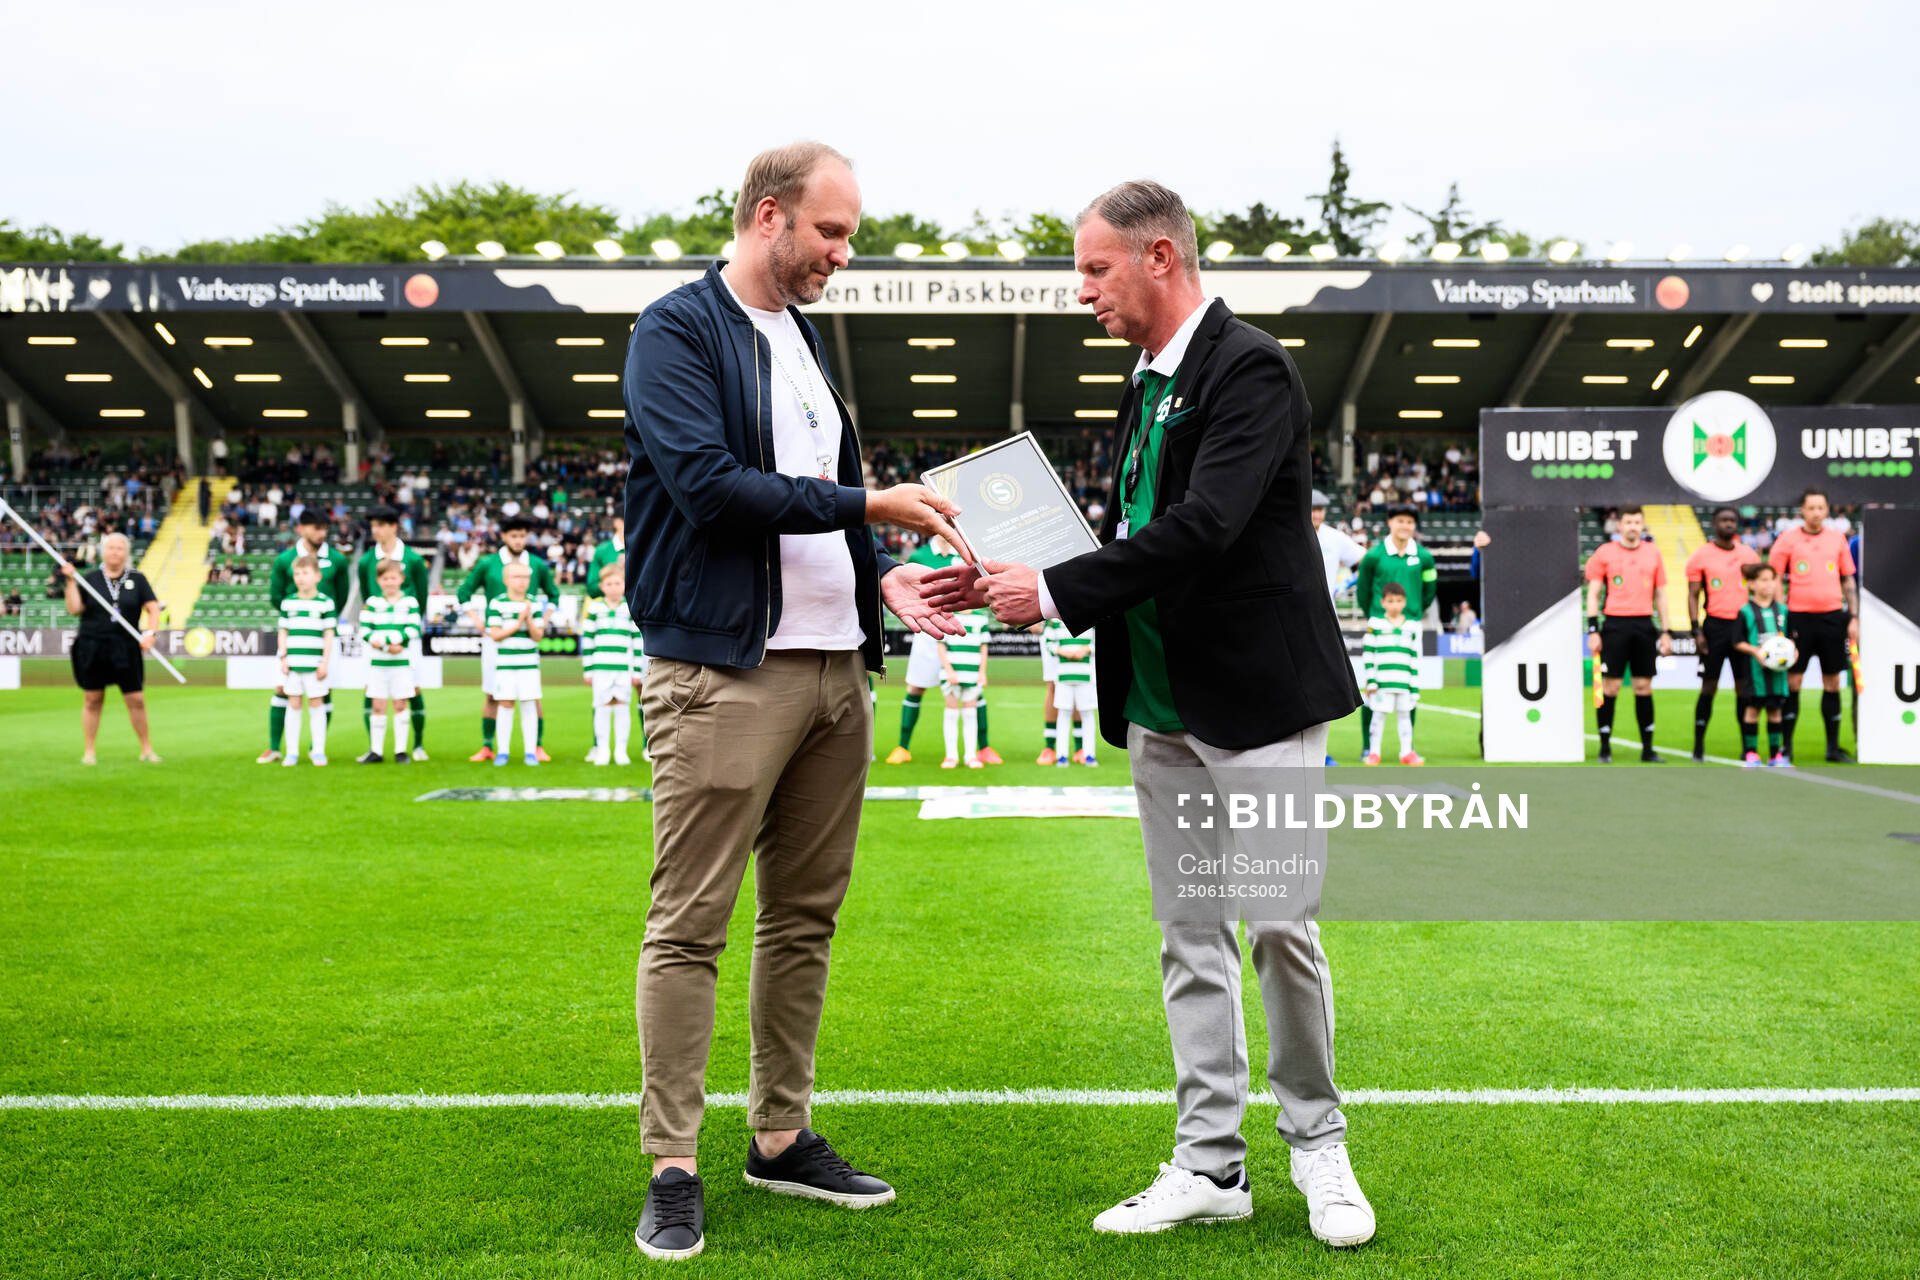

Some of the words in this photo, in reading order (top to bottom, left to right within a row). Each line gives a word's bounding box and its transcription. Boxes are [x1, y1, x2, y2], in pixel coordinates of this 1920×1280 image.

[178, 276, 277, 308] Varbergs
[280, 276, 385, 307] Sparbank
[874, 281, 913, 303] till
[1431, 278, 1529, 310] Varbergs
[1532, 278, 1636, 310] Sparbank
[1787, 280, 1844, 304] Stolt
[1506, 430, 1638, 461] UNIBET
[1518, 663, 1548, 702] U
[1895, 664, 1920, 703] U
